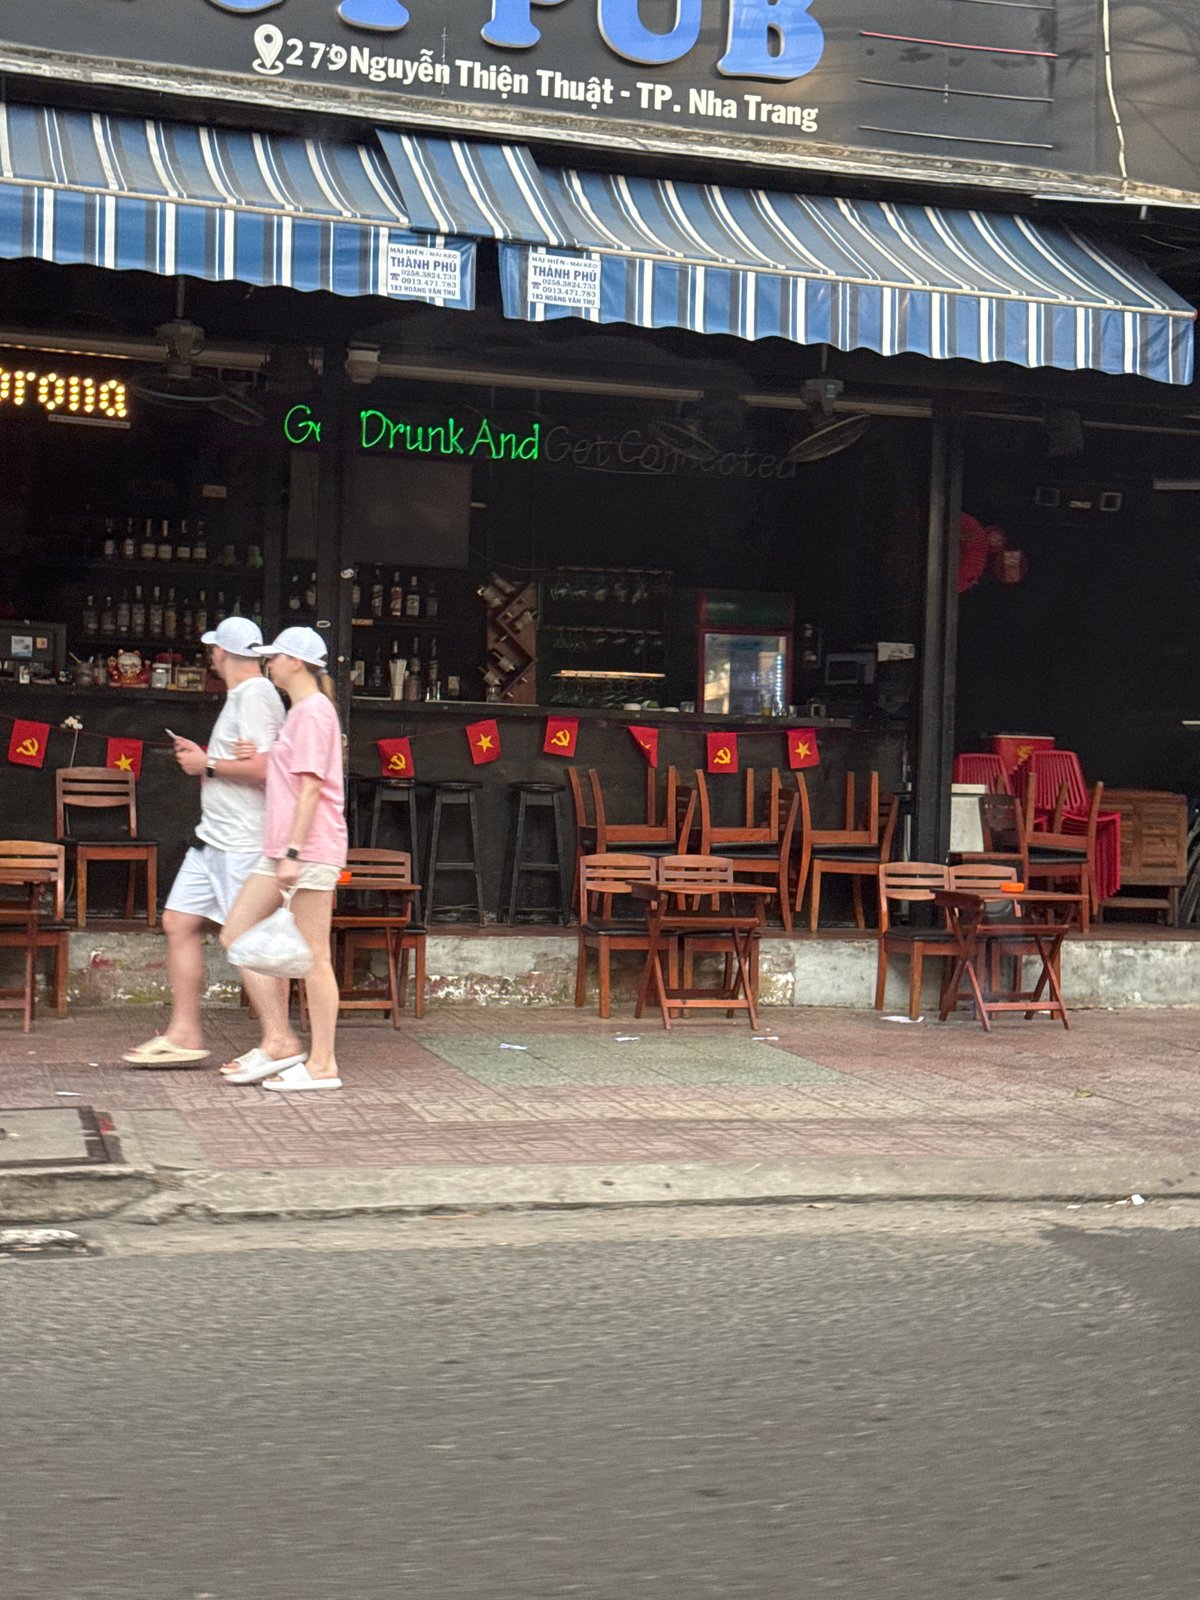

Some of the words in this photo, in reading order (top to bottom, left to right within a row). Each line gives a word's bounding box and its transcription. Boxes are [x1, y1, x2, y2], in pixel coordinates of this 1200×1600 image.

[286, 38, 348, 72] 279
[349, 46, 451, 84] Nguyễn
[454, 59, 529, 99] Thiện
[535, 69, 615, 109] Thuật
[635, 82, 682, 113] TP.
[688, 88, 738, 119] Nha
[743, 95, 819, 132] Trang
[390, 256, 430, 270] THÀNH
[532, 265, 570, 280] THÀNH
[359, 409, 465, 454] Drunk
[469, 418, 540, 460] And
